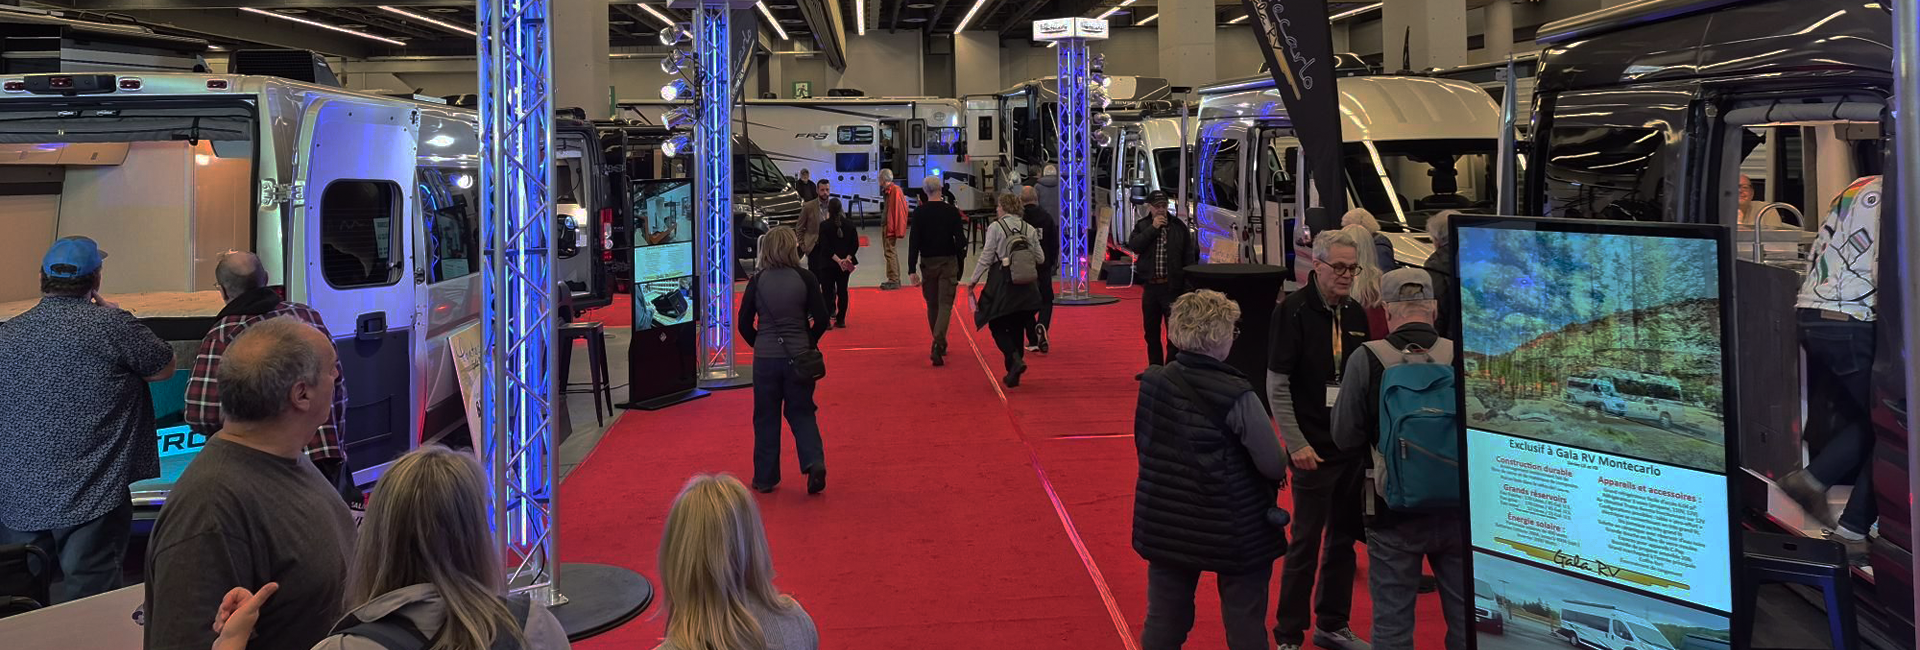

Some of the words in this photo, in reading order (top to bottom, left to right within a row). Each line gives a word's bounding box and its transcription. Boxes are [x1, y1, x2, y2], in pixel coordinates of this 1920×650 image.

[1267, 22, 1283, 49] RV
[795, 132, 829, 140] FR3
[1496, 455, 1542, 471] Construction
[1543, 465, 1573, 477] durable
[1509, 440, 1545, 454] Exclusif
[1547, 445, 1553, 456] à
[1556, 448, 1578, 461] Gala
[1581, 453, 1595, 463] RV
[1598, 456, 1661, 476] Montecarlo
[1504, 484, 1529, 495] Grands
[1598, 476, 1636, 490] Appareils
[1637, 484, 1647, 492] et
[1648, 487, 1697, 502] accessoires
[1536, 521, 1561, 531] solaire
[1554, 549, 1592, 570] Gala
[1596, 560, 1620, 577] RV
